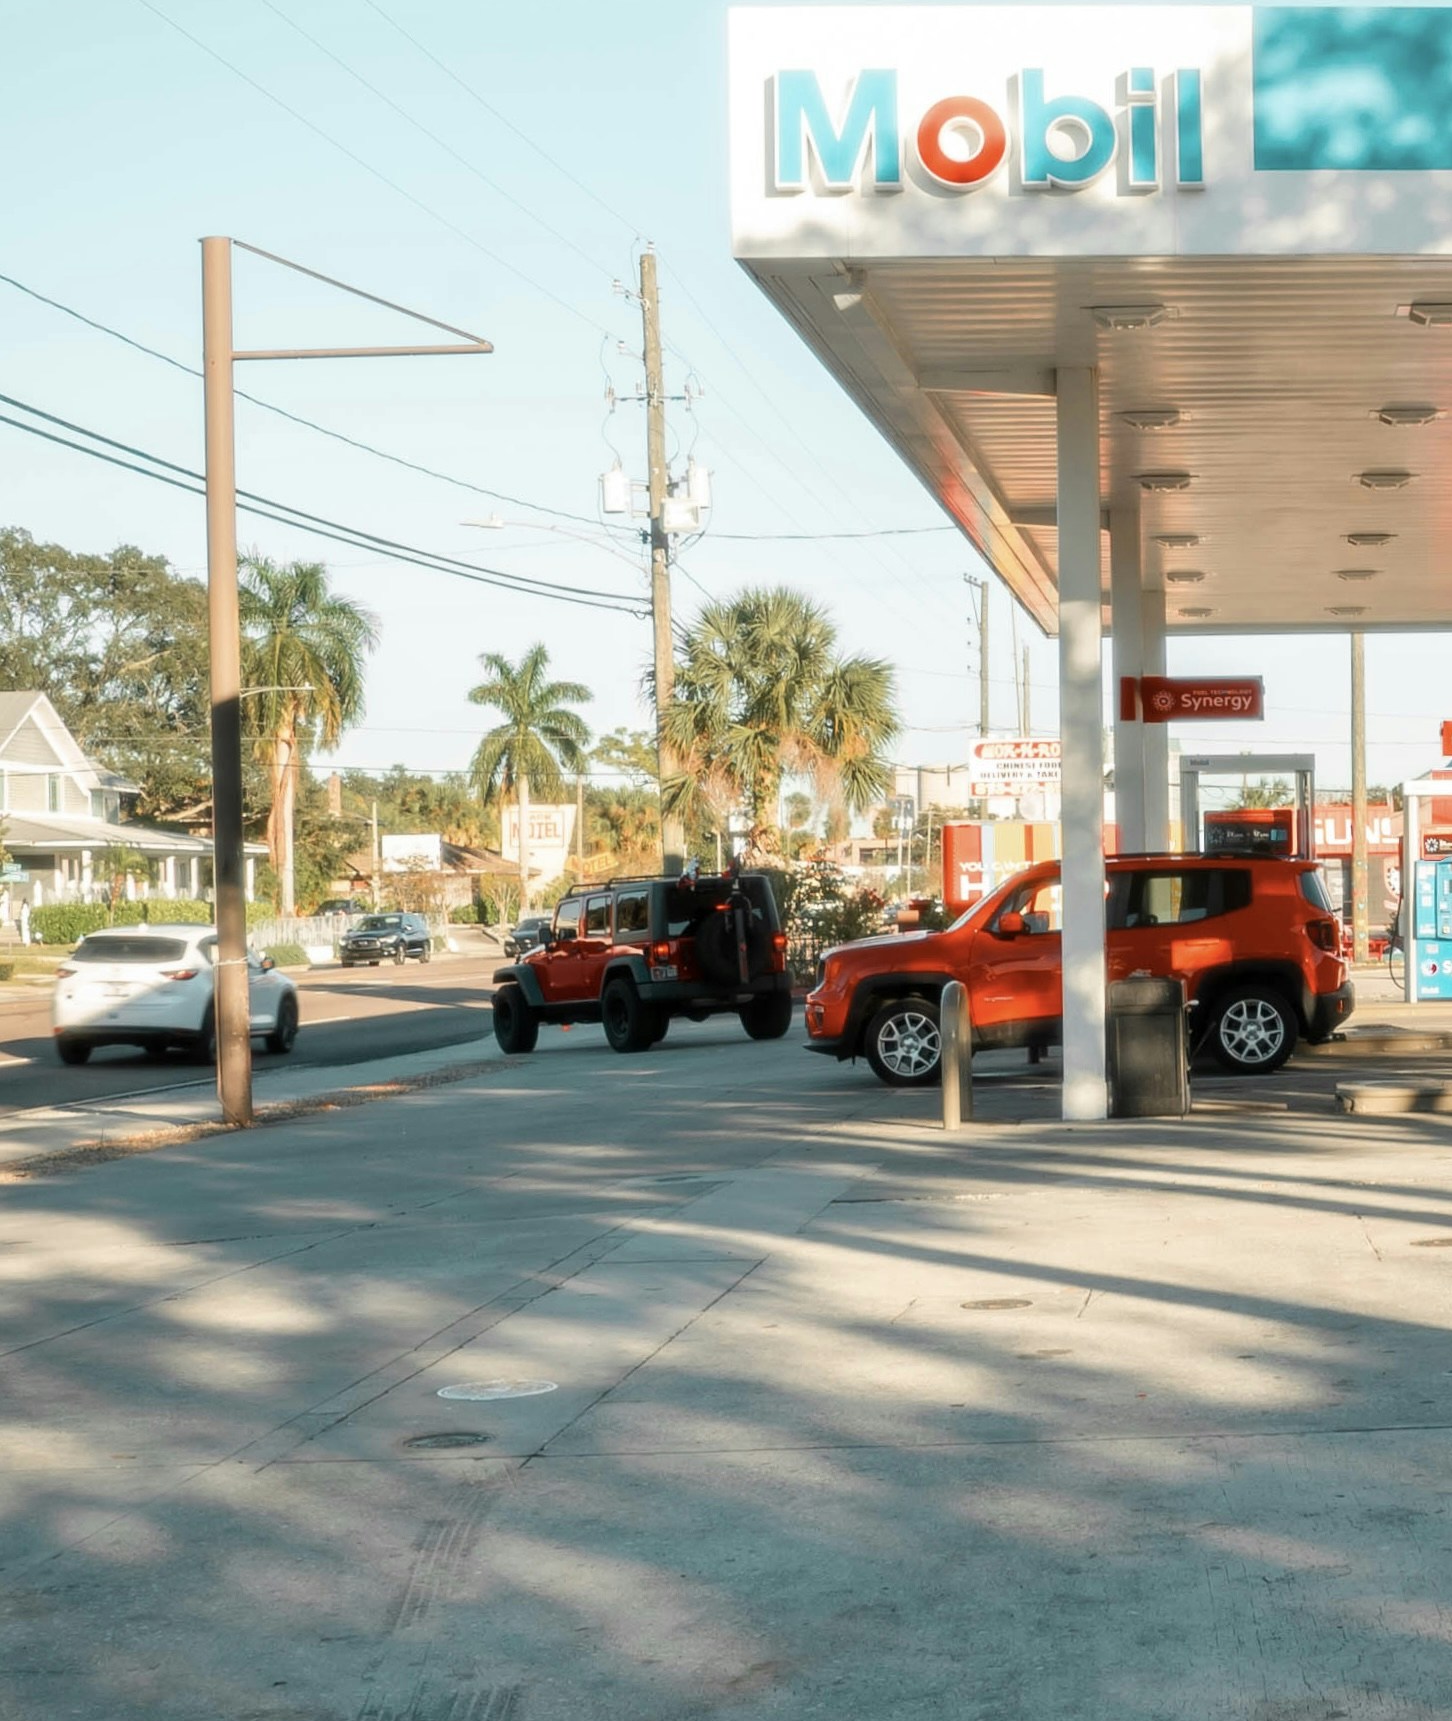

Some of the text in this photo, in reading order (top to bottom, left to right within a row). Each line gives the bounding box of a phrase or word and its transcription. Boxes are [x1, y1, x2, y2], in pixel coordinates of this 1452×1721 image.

[770, 67, 1204, 188] Mobil
[1181, 694, 1252, 711] Synergy
[996, 762, 1035, 770] CHINESE
